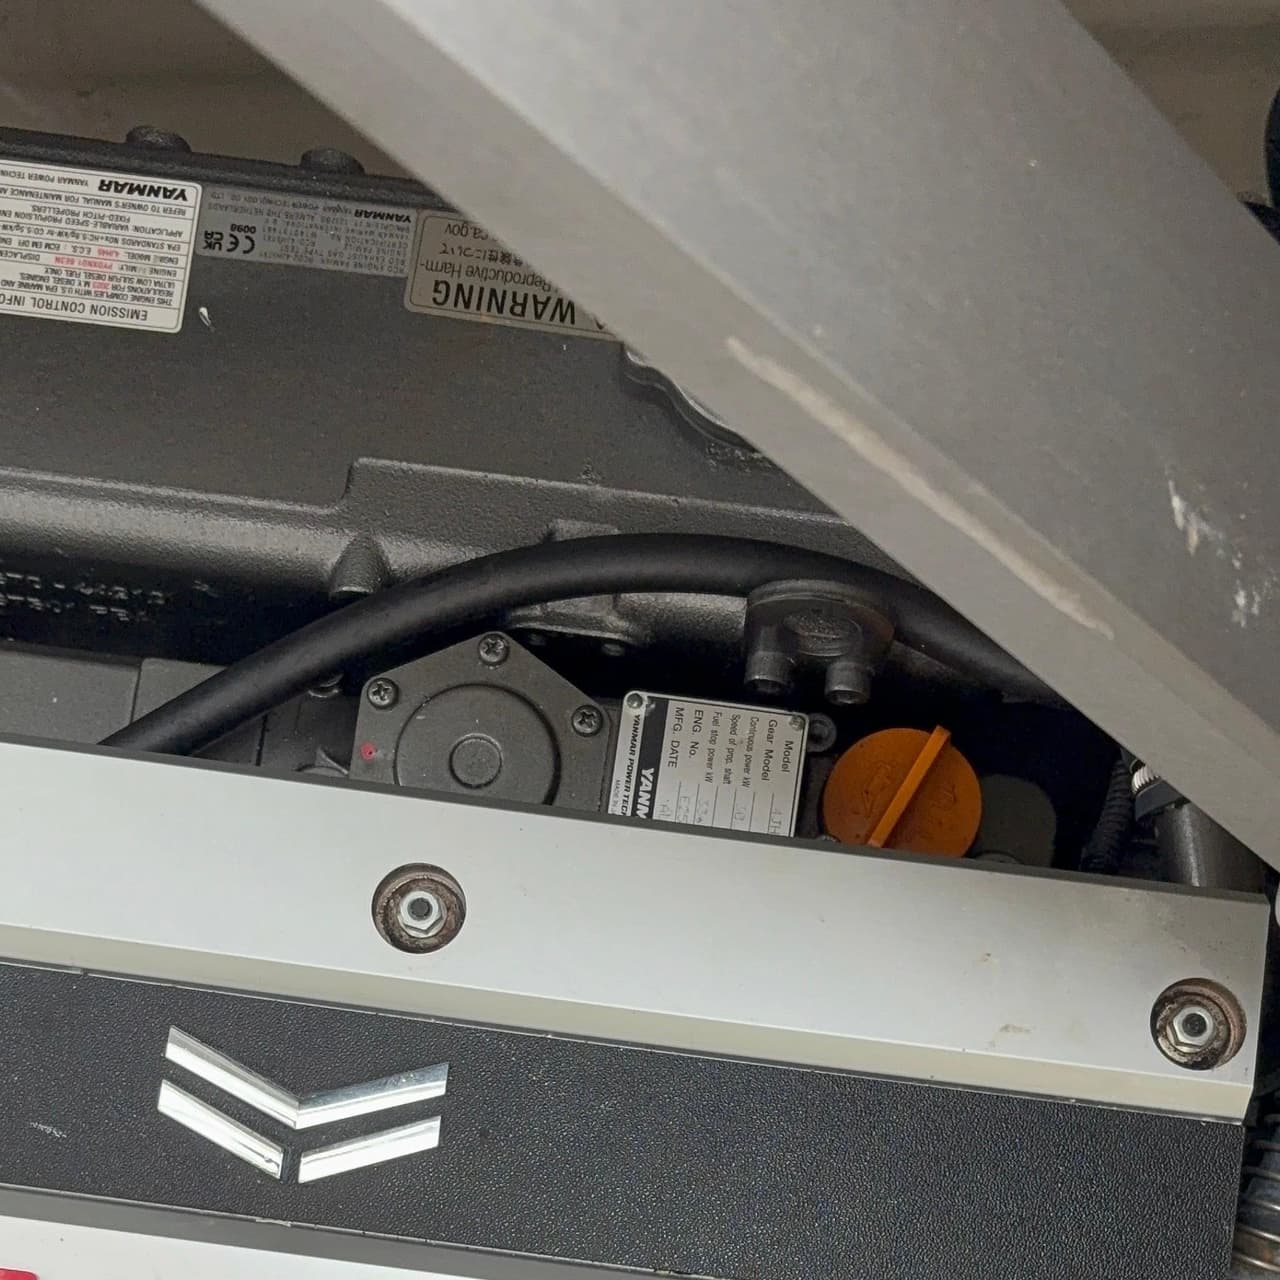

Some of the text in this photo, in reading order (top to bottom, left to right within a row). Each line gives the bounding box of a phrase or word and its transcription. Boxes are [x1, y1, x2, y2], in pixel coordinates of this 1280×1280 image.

[27, 172, 55, 182] POWER
[56, 176, 88, 187] YANMAR
[9, 187, 62, 201] MAINTENANCE
[97, 177, 189, 202] YANMAR
[64, 194, 79, 203] FOR
[81, 196, 112, 207] MANUAL
[13, 210, 62, 223] PROPULSION
[162, 206, 186, 216] REFER
[353, 208, 412, 224] YANMAR
[120, 237, 164, 249] STANDARDS
[166, 242, 181, 251] EPA
[201, 239, 223, 251] UK
[63, 269, 80, 278] FUEL
[82, 271, 106, 280] DIESEL
[148, 267, 176, 277] ENGINE
[419, 256, 552, 293] Reproductive Harm-
[0, 279, 15, 288] AND
[51, 276, 75, 286] DIESEL
[107, 274, 134, 284] SULFUR
[136, 277, 152, 286] LOW
[152, 279, 175, 288] ULTRA
[17, 280, 43, 291] MARINE
[44, 284, 58, 292] EPA
[74, 287, 91, 296] WITH
[110, 283, 125, 291] FOR
[126, 285, 173, 297] REGULATIONS
[129, 293, 154, 303] ENGINE
[155, 296, 172, 305] THIS
[430, 278, 578, 326] WARNING
[29, 296, 85, 313] CONTROL
[89, 303, 148, 320] EMISSION
[691, 709, 704, 735] ENG.
[711, 711, 721, 726] Fuel
[727, 713, 741, 735] Speed
[627, 714, 641, 755] YANMAR
[667, 707, 685, 768] MFG. DATE
[708, 729, 718, 745] stop
[746, 716, 759, 752] Continuous
[688, 740, 699, 759] No.
[761, 719, 778, 781] Gear Model
[704, 747, 715, 770] power
[781, 740, 794, 772] Model
[741, 753, 752, 774] power
[622, 758, 634, 792] POWER
[722, 767, 733, 785] shaft
